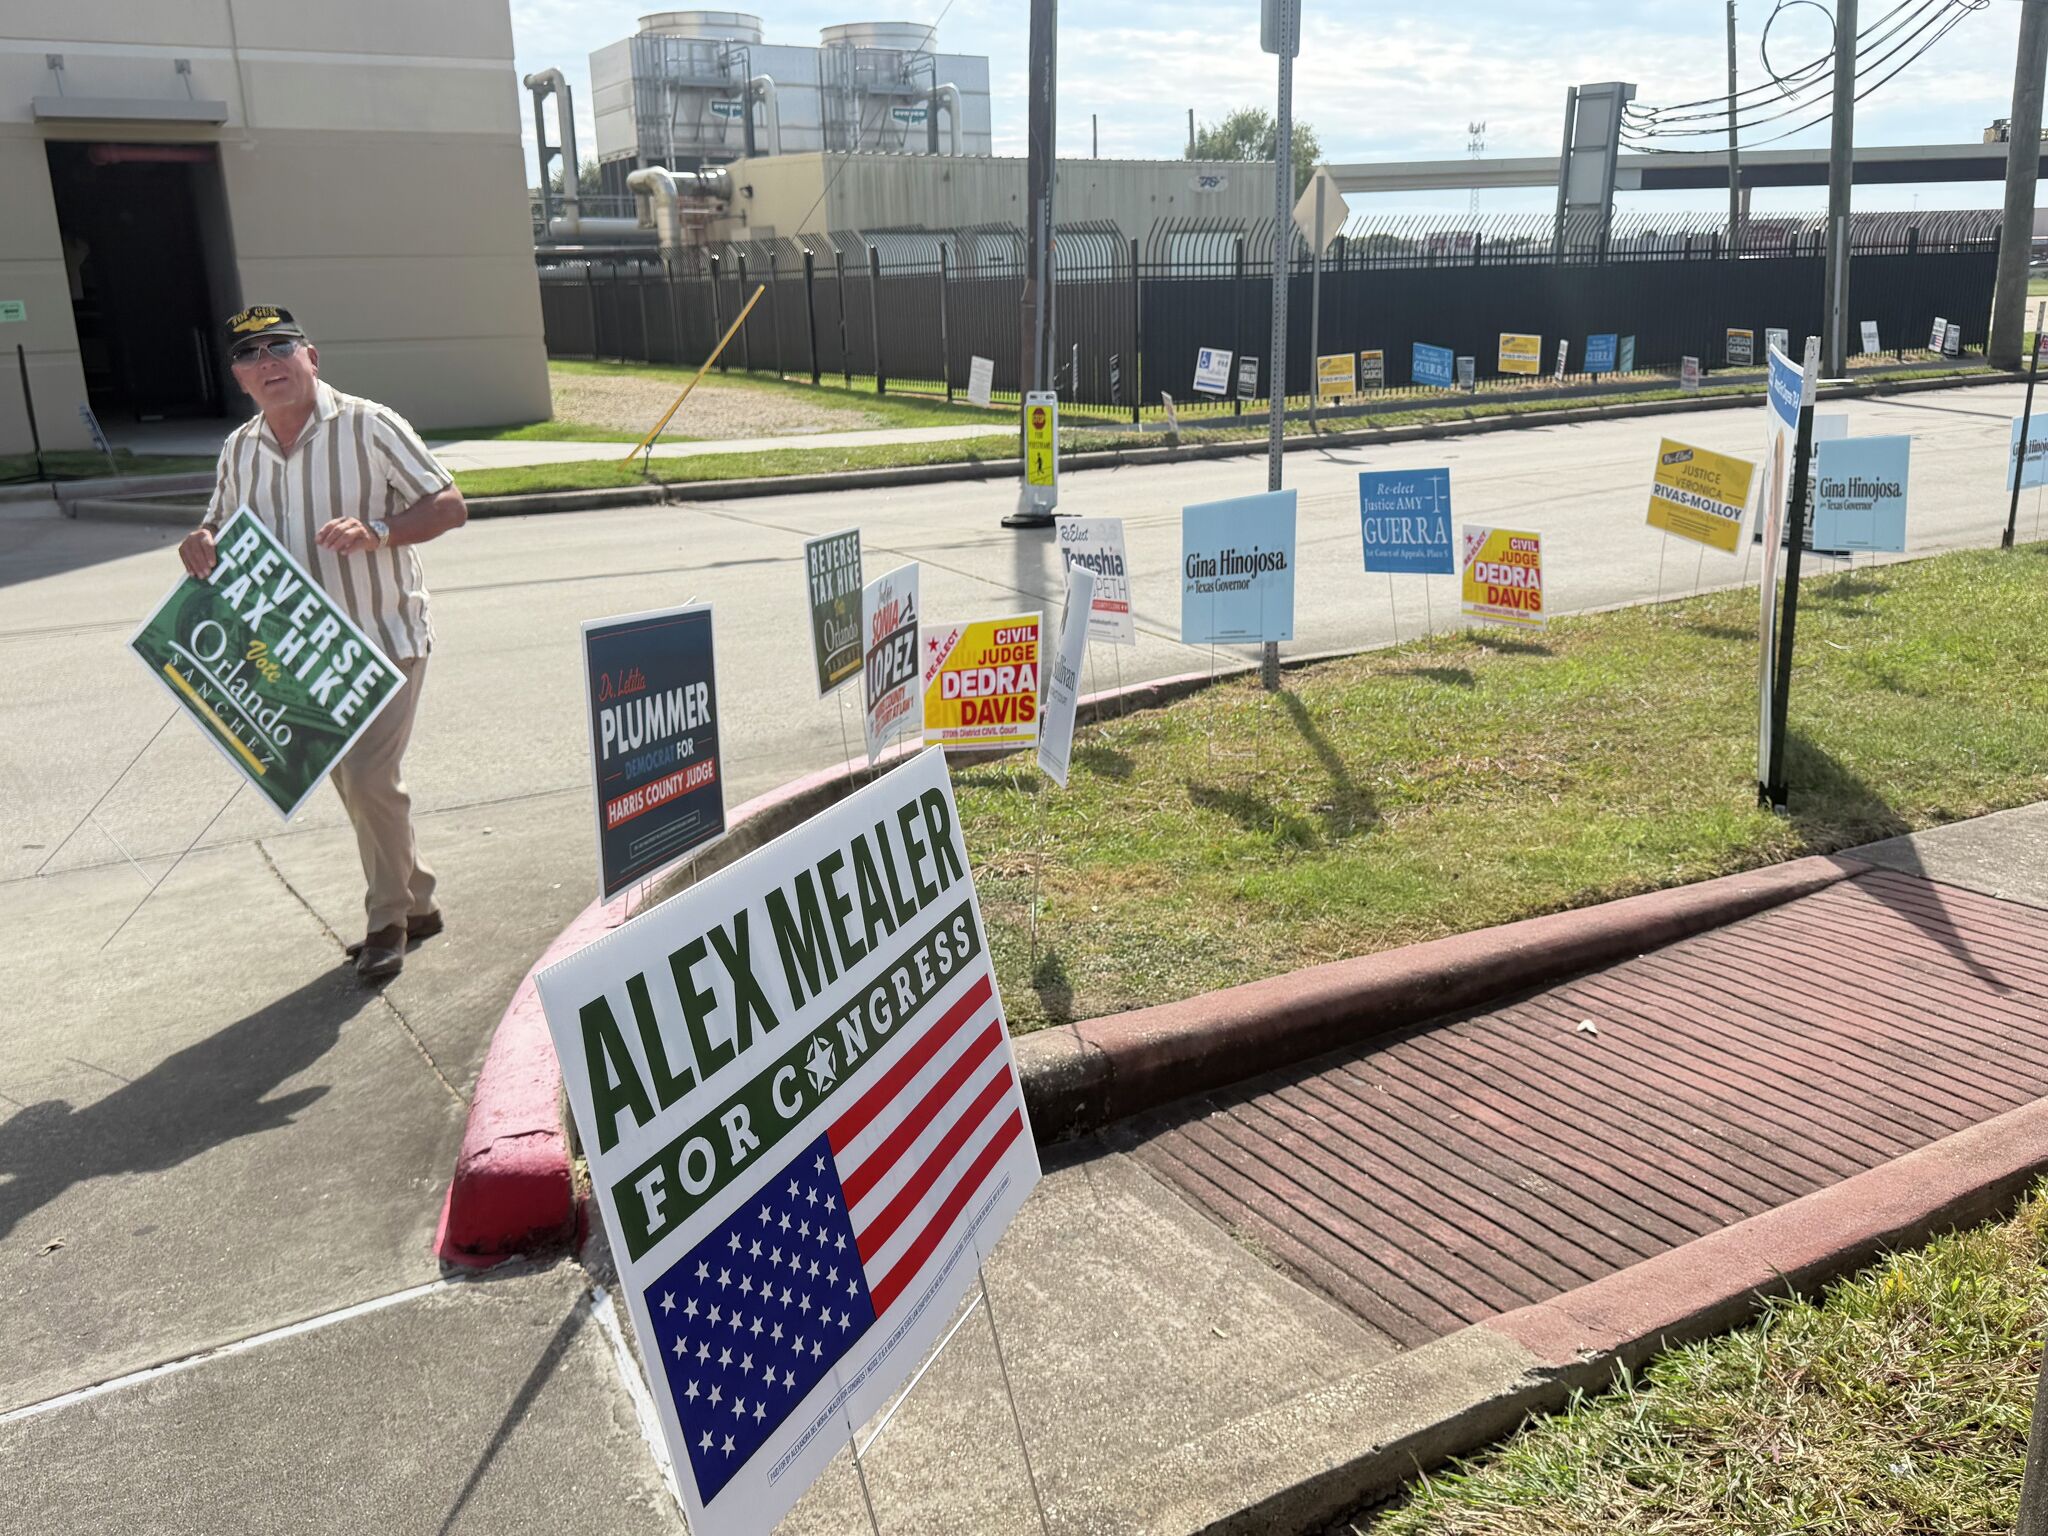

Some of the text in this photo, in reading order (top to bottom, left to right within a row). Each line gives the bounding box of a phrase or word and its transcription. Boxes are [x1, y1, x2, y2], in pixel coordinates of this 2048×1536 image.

[230, 310, 249, 327] TOP
[1413, 360, 1449, 378] GUERRA
[1377, 481, 1415, 495] Re-elect
[1675, 476, 1723, 499] VERONICA
[1681, 465, 1721, 484] JUSTICE
[1820, 477, 1845, 498] Gina
[1364, 496, 1422, 513] Justice AMY
[1653, 484, 1742, 520] RIVAS-MOLLOY
[1827, 500, 1843, 510] Texas
[1844, 500, 1873, 510] Governor
[1364, 516, 1449, 545] GUERRA
[1511, 538, 1538, 552] CIVIL
[811, 534, 859, 576] REVERSE
[1186, 552, 1216, 579] Gina
[1499, 551, 1539, 566] JUDGE
[812, 570, 834, 606] TAX
[836, 562, 861, 597] HIKE
[1195, 580, 1214, 593] Texas
[1215, 578, 1251, 592] Governor
[1475, 561, 1541, 590] DEDRA
[229, 527, 385, 697] REVERSE
[1488, 586, 1541, 612] DAVIS
[824, 614, 858, 651] Orlando
[872, 599, 899, 646] SONIA
[996, 626, 1036, 645] CIVIL
[208, 551, 363, 727] TAX HIKE
[246, 640, 281, 683] Vote
[869, 630, 914, 707] LOPEZ
[925, 628, 959, 681] RE-ELECT
[978, 644, 1035, 665] JUDGE
[191, 620, 292, 746] Orlando
[599, 673, 616, 702] Dr.
[942, 663, 1036, 699] DEDRA
[169, 652, 275, 768] SANCHEZ
[600, 682, 711, 760] PLUMMER
[961, 695, 1035, 726] DAVIS
[960, 728, 981, 738] District
[982, 727, 999, 737] CIVIL
[1000, 726, 1018, 735] Court
[625, 738, 694, 780] DEMOCRAT FOR
[608, 761, 713, 823] HARRIS COUNTY JUDGE
[579, 787, 964, 1155] ALEX MEALER
[635, 1103, 760, 1236] FOR
